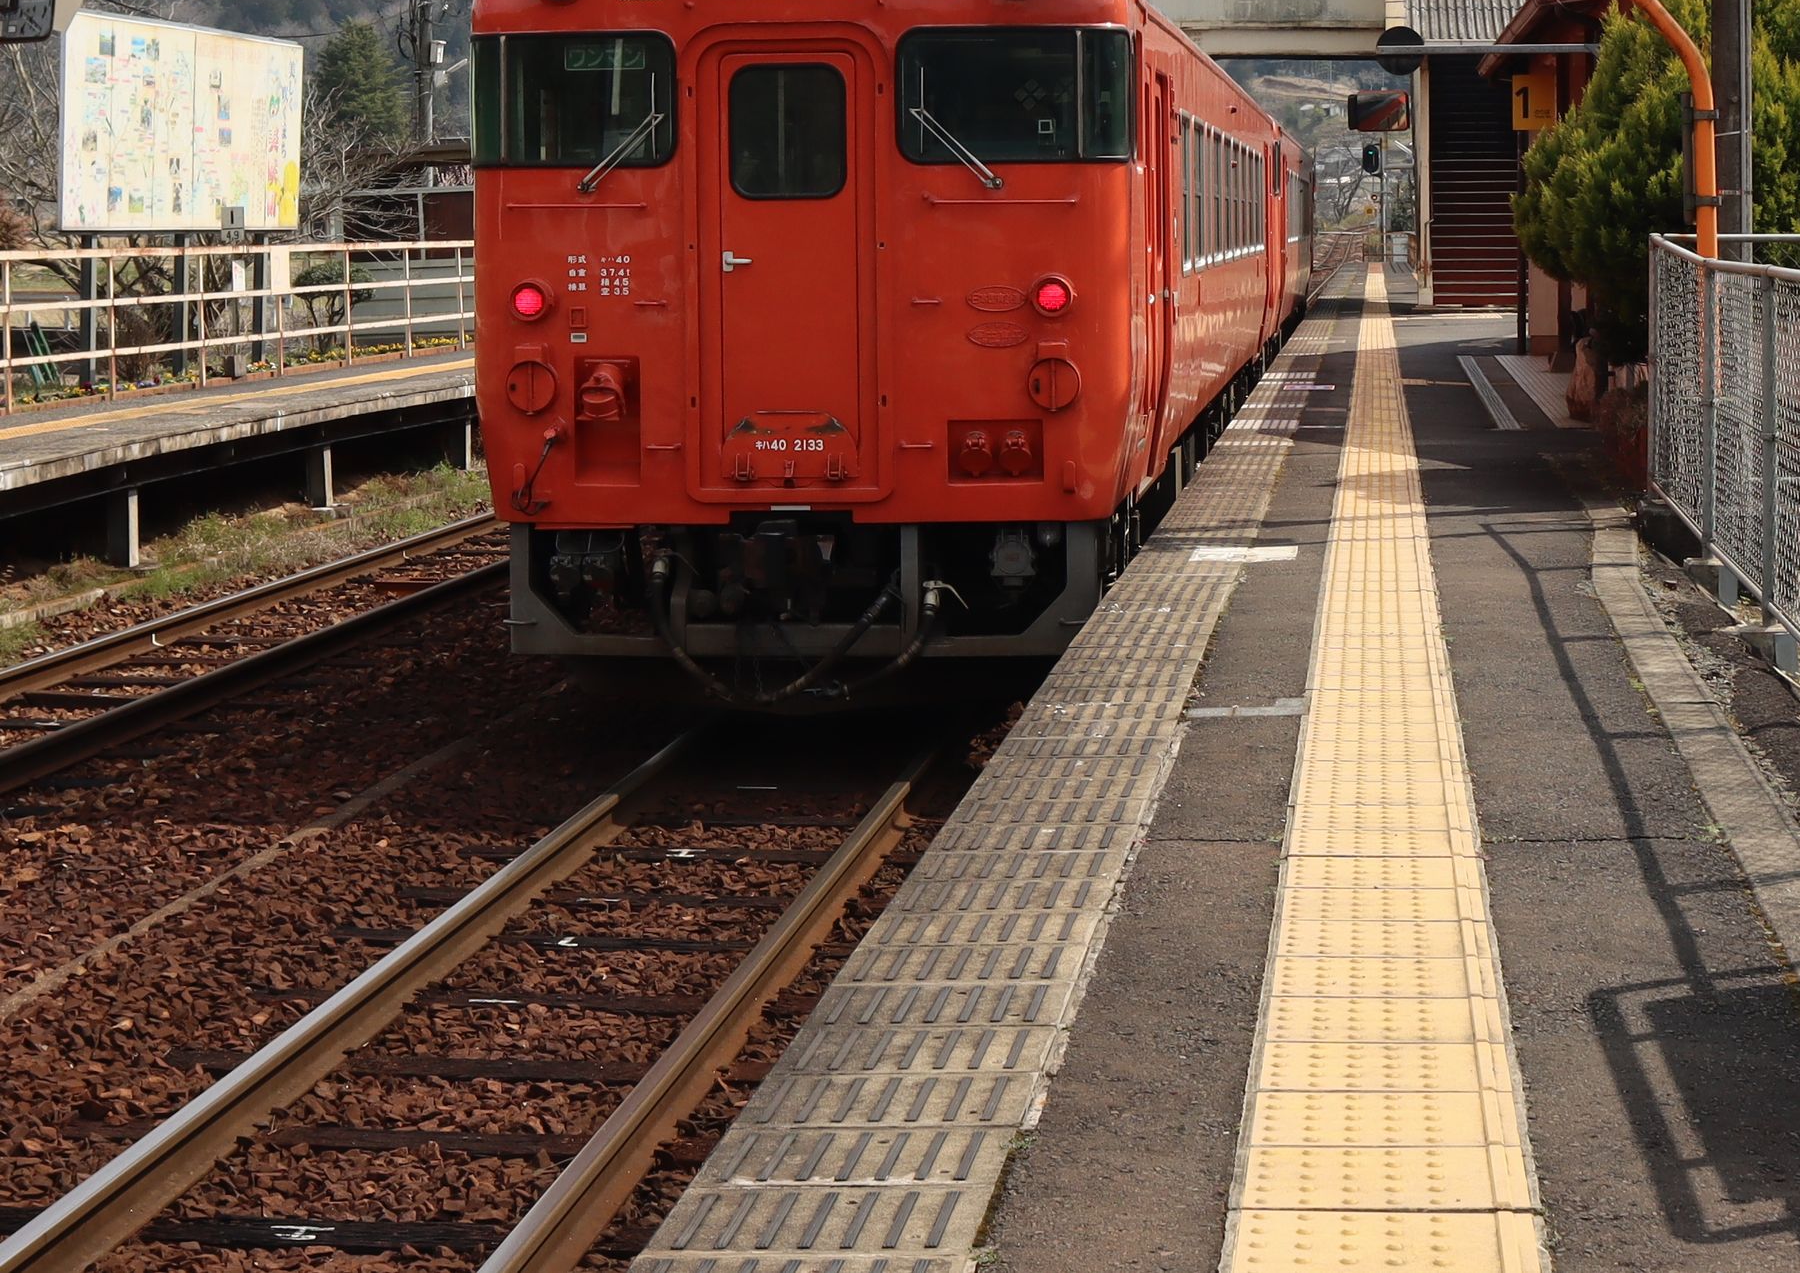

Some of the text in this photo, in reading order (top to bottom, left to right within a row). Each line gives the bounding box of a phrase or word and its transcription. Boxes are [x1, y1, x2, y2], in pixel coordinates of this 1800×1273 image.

[1515, 86, 1529, 118] 1
[567, 255, 587, 264] 形式
[613, 287, 629, 296] 3.5
[755, 439, 824, 451] キハ40 2133
